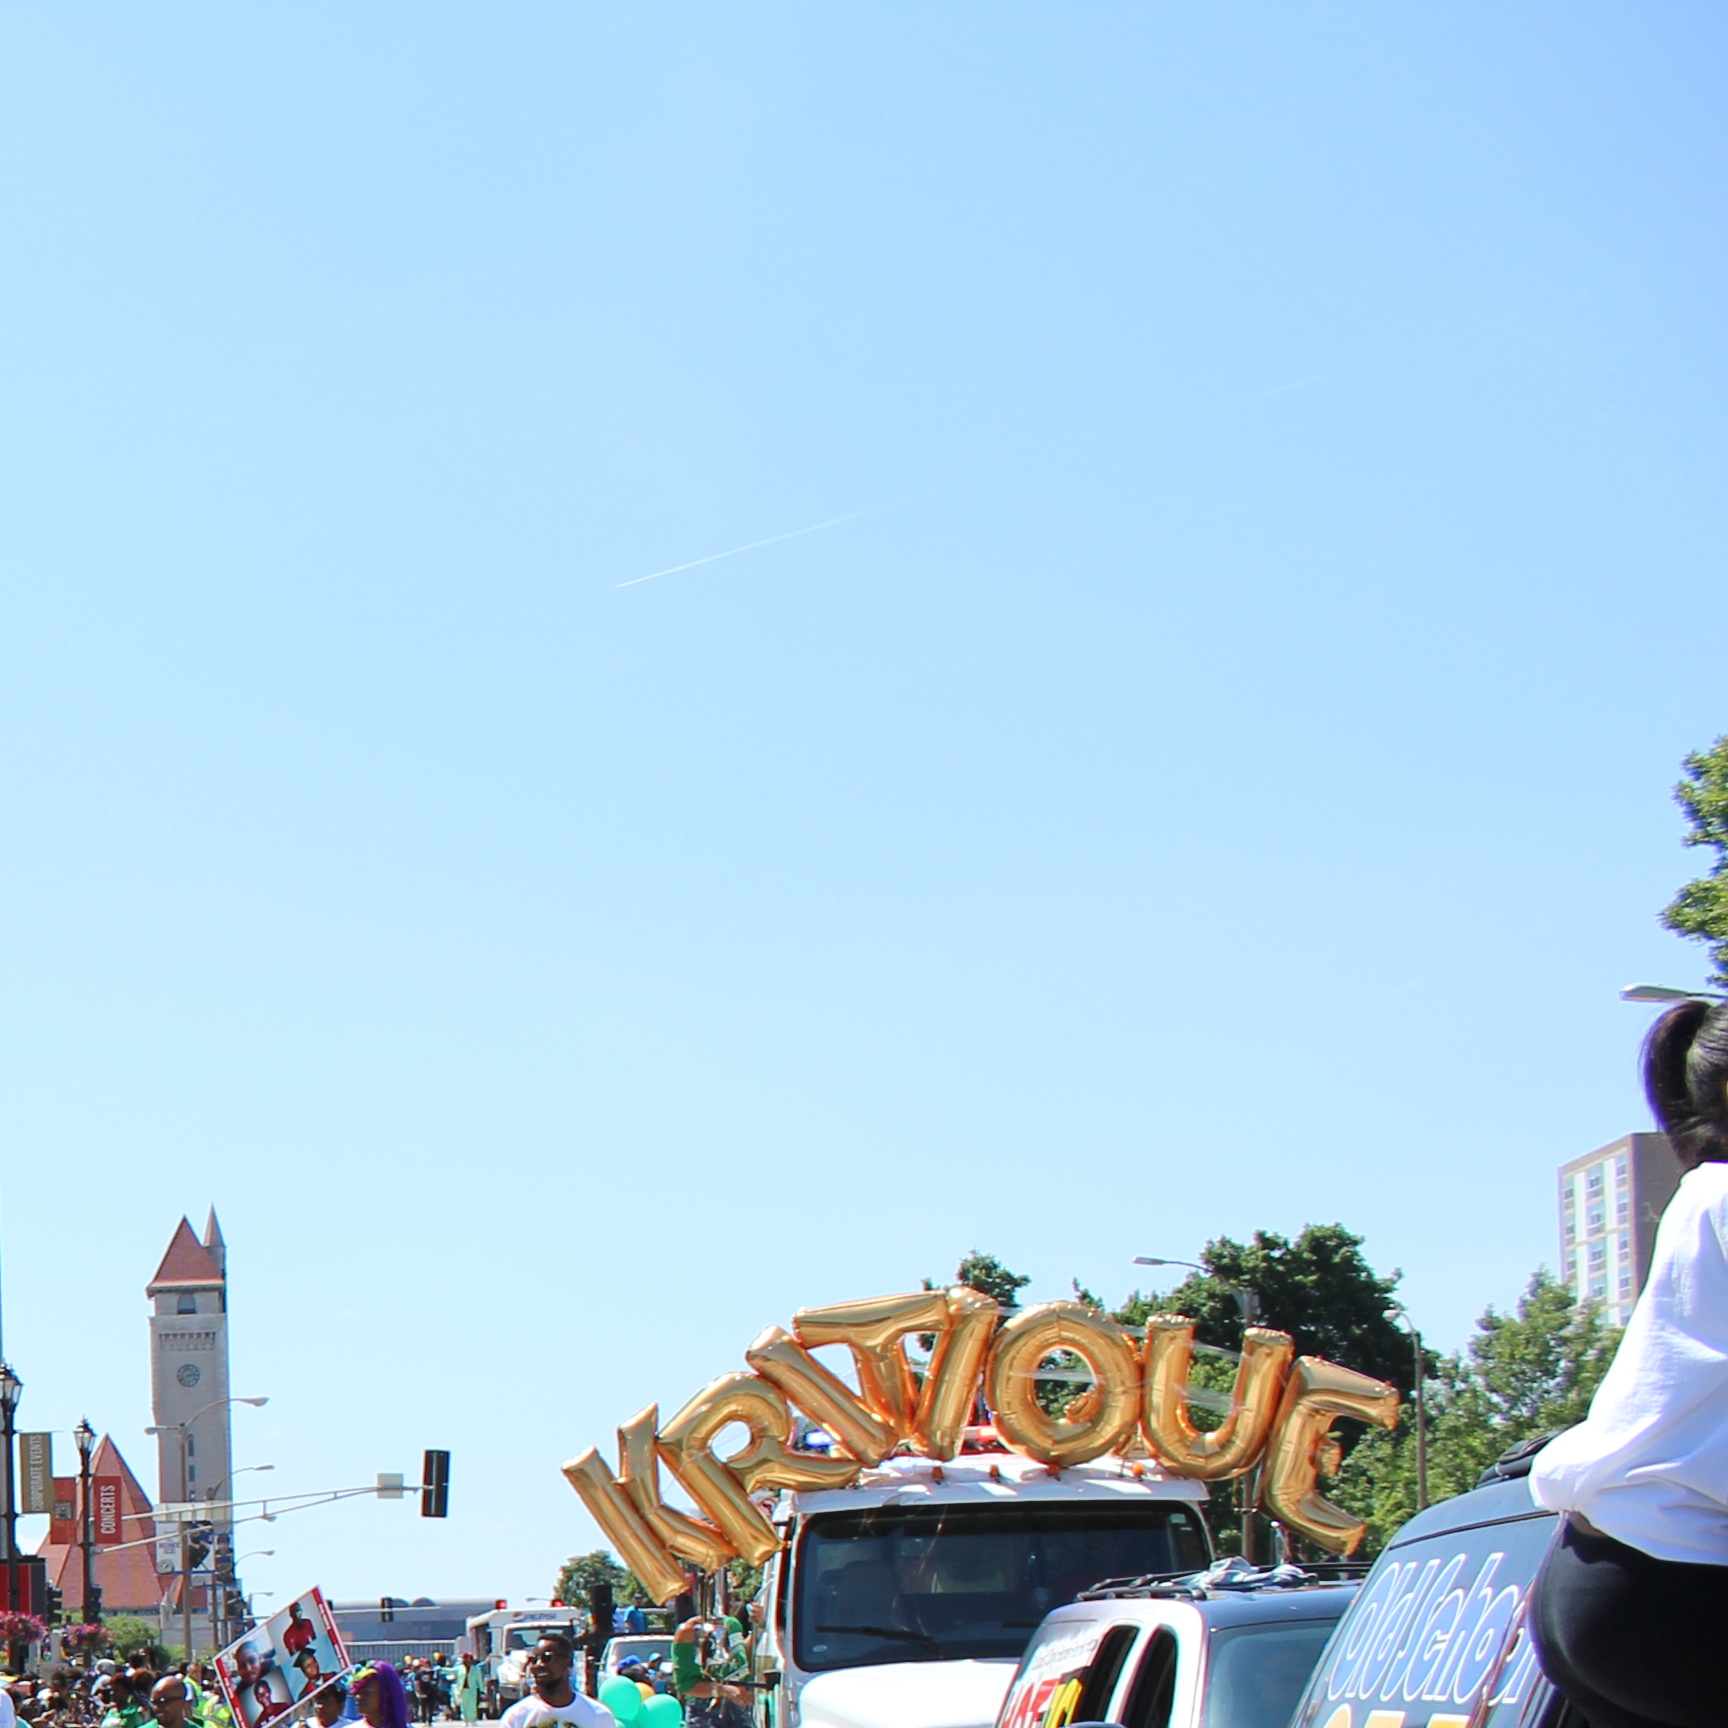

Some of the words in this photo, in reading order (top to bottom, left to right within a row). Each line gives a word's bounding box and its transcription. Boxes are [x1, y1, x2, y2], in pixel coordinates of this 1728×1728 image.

[29, 1435, 43, 1465] EVENTS
[561, 1284, 1399, 1603] KRITIQUE
[30, 1465, 44, 1512] CORPORATE
[100, 1485, 116, 1535] CONCERTS
